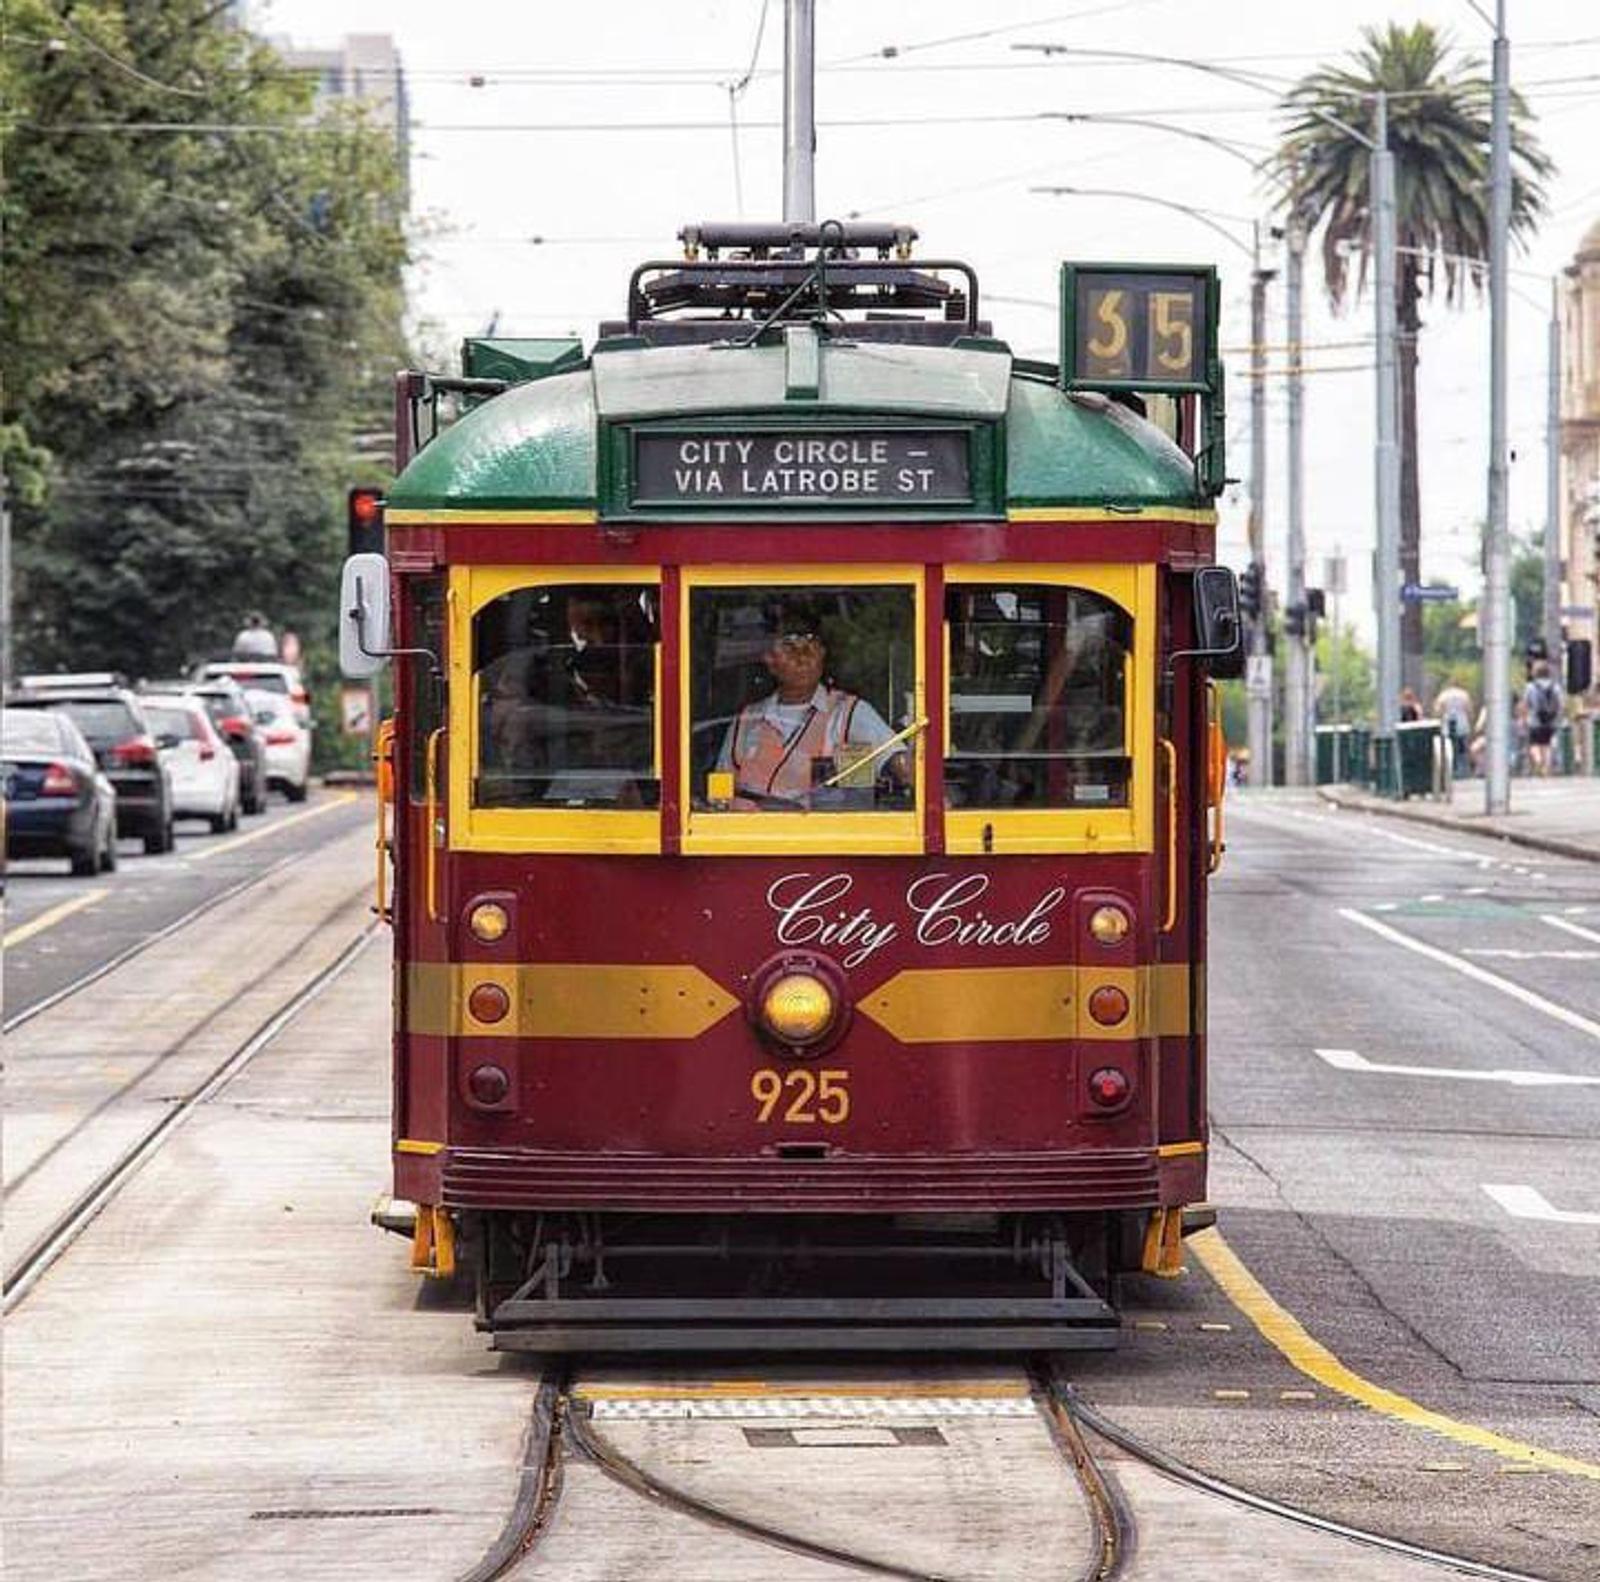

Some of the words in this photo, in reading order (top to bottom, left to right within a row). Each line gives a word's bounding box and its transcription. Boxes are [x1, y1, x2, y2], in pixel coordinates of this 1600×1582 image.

[679, 440, 753, 464] CITY
[774, 440, 888, 464] CIRCLE
[674, 469, 724, 493] VIA
[742, 468, 879, 493] LATROBE
[898, 468, 934, 493] ST
[766, 873, 897, 968] City
[906, 873, 1066, 946] Circle
[751, 1069, 850, 1124] 925
